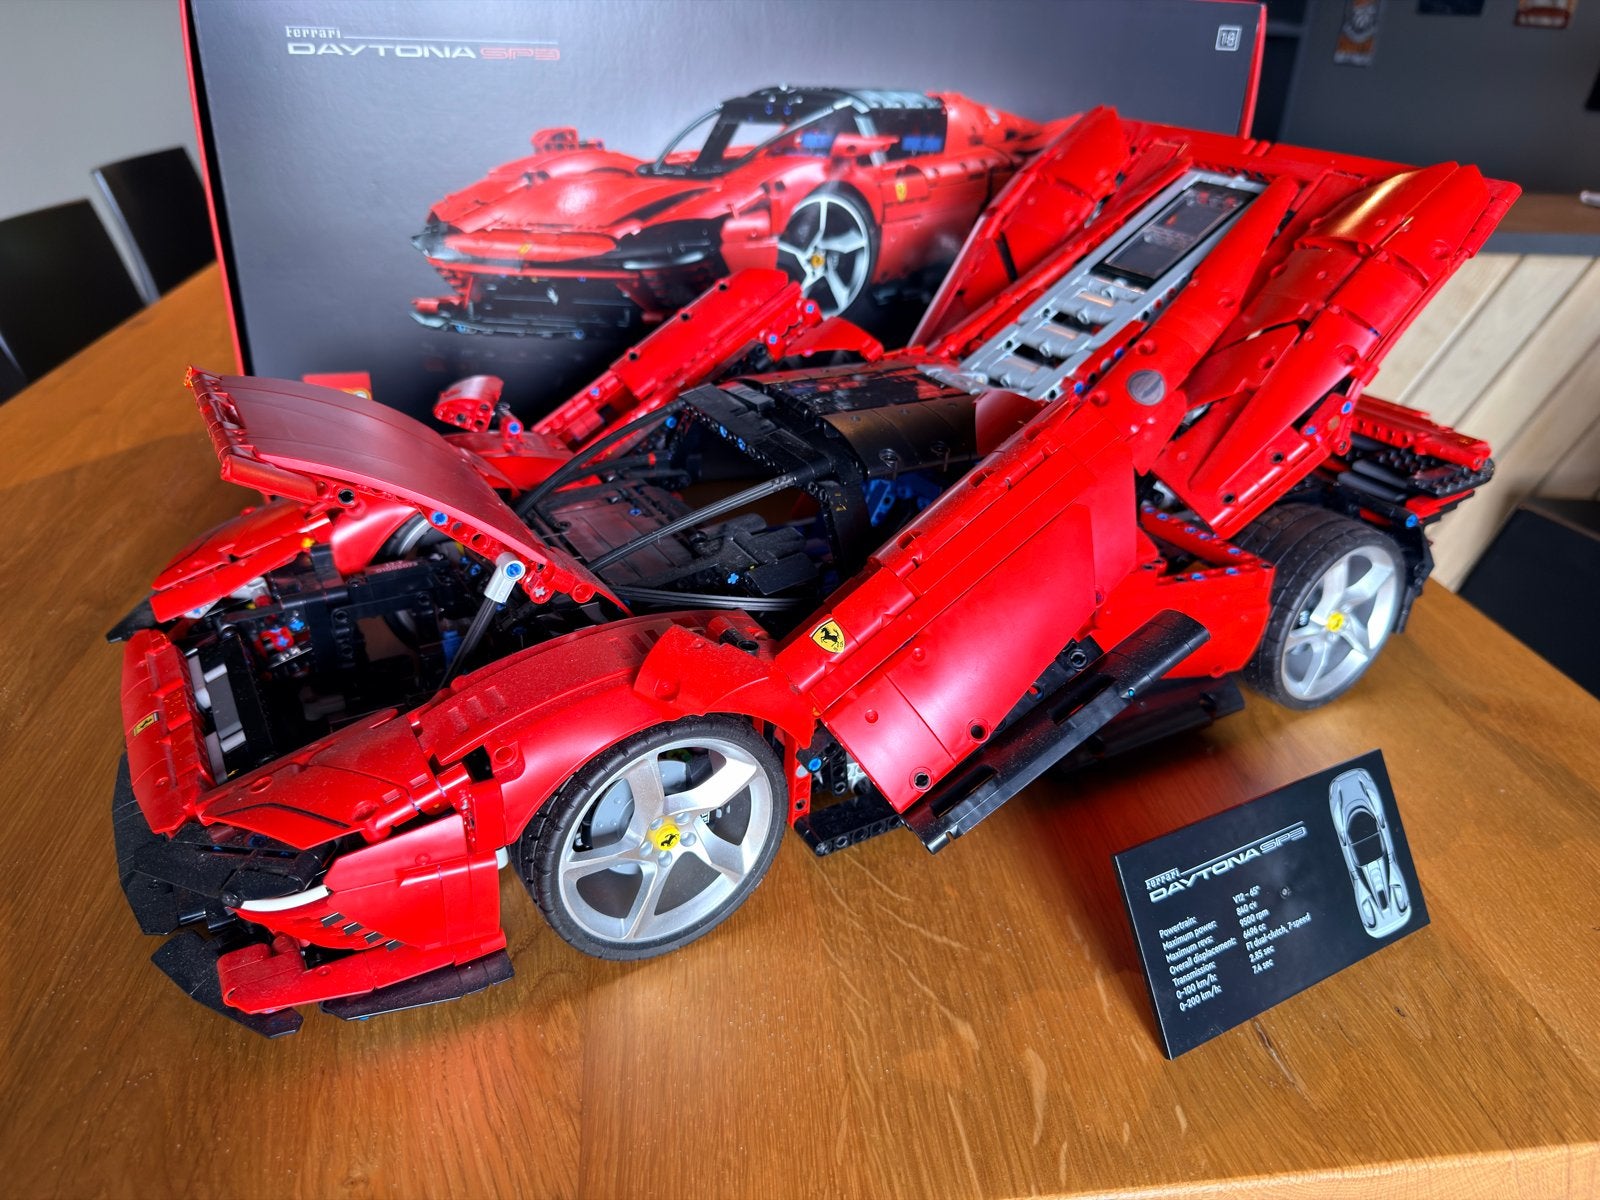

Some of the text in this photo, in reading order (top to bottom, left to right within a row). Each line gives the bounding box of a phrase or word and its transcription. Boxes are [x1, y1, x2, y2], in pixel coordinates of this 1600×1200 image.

[285, 26, 341, 39] Ferrari
[287, 42, 561, 61] DAYTONA SP3
[1149, 826, 1308, 904] DAYTONA SP3
[1145, 867, 1181, 890] Ferrari
[1232, 892, 1245, 904] V12
[1235, 901, 1258, 916] 840 cv
[1159, 916, 1198, 939] Powertrain:
[1239, 908, 1270, 928] 9500 rpm
[1257, 923, 1267, 933] cc
[1162, 920, 1218, 951] Maximum power:
[1253, 925, 1289, 948] dual-clutch,
[1287, 912, 1312, 930] 7-speed
[1166, 935, 1215, 964] Maximum revs:
[1169, 937, 1238, 975] Overall displacement:
[1249, 945, 1275, 963] 2.85 sec
[1172, 961, 1217, 987] Transmission:
[1262, 958, 1274, 970] sec
[1176, 973, 1218, 999] 0-100 km/h:
[1179, 984, 1223, 1012] 0-200 km/h:
